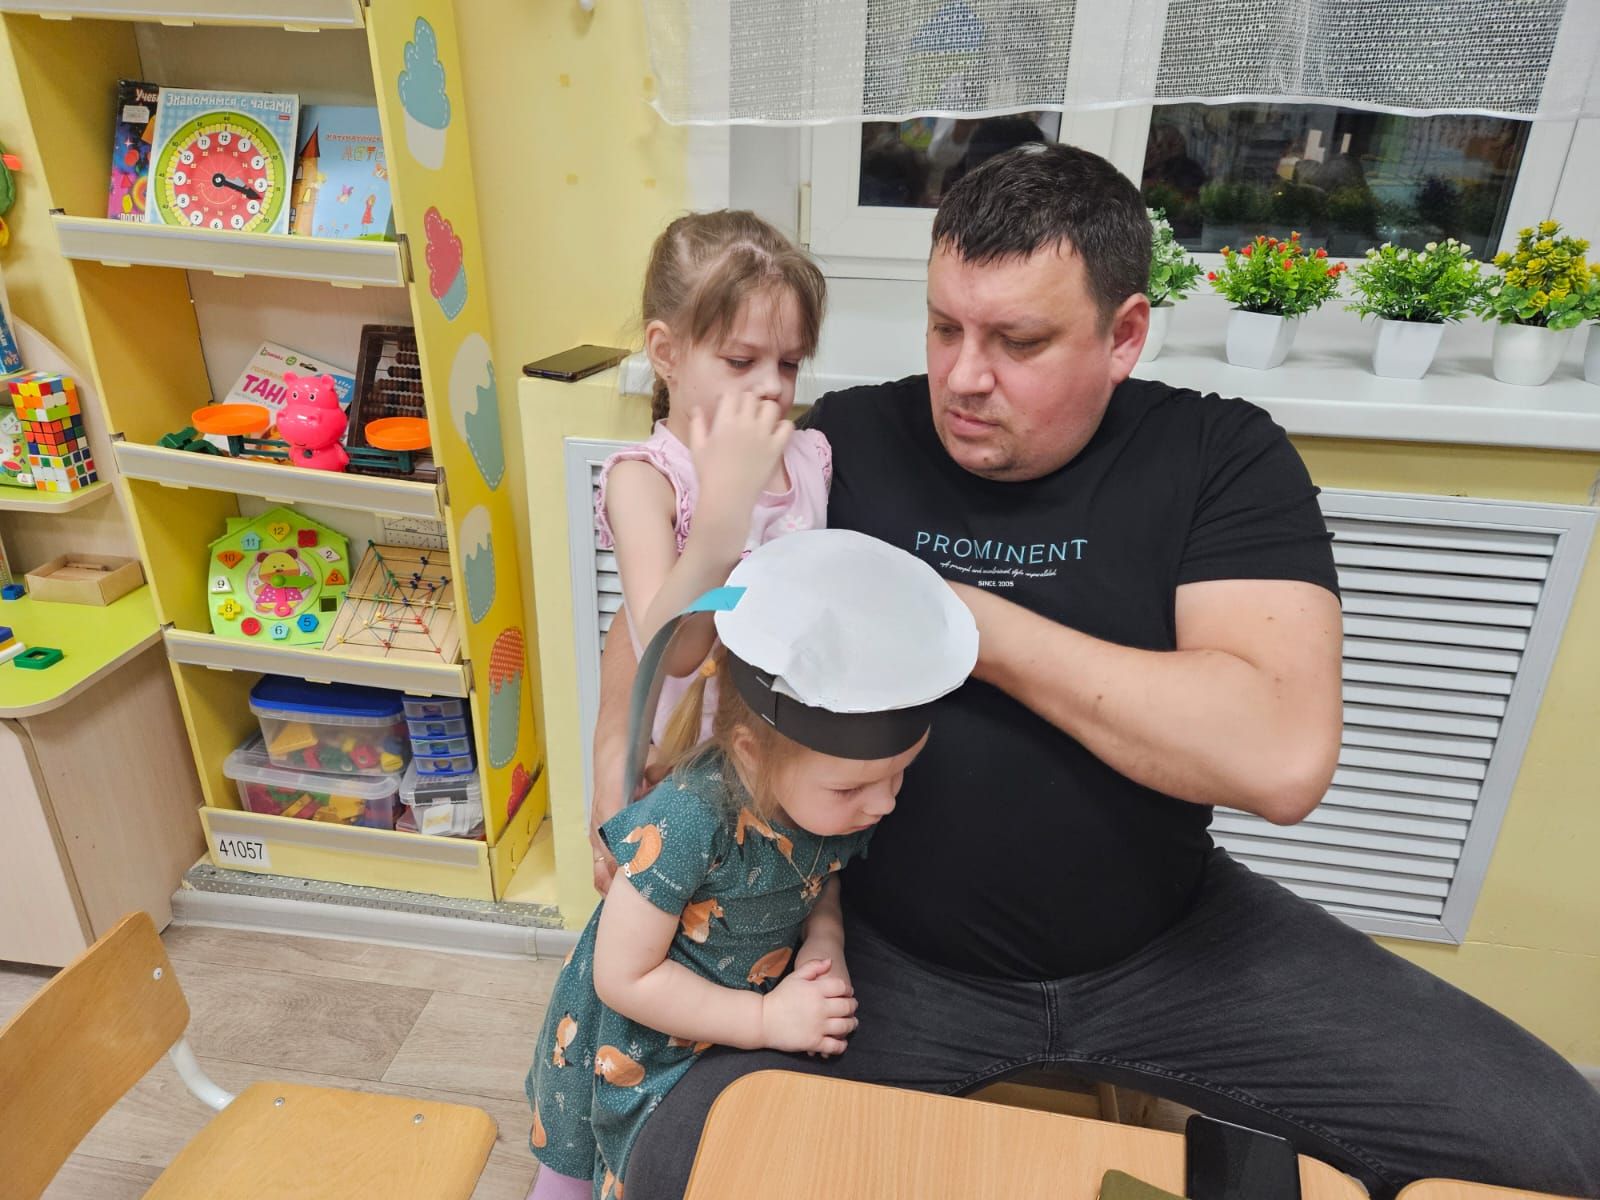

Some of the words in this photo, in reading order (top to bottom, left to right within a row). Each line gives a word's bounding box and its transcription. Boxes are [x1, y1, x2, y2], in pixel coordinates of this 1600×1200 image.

[166, 93, 237, 106] Знакомимся
[241, 99, 247, 107] с
[250, 99, 292, 114] часами
[221, 134, 228, 142] 12
[255, 159, 260, 167] 2
[273, 526, 284, 536] 12
[246, 538, 255, 546] 11
[915, 531, 1088, 565] PROMINENT
[224, 553, 235, 562] 10
[325, 550, 333, 560] 2
[331, 573, 339, 582] 3
[217, 580, 225, 589] 9
[224, 603, 233, 613] 8
[304, 617, 312, 627] 5
[275, 625, 283, 635] 6
[220, 840, 263, 860] 41057
